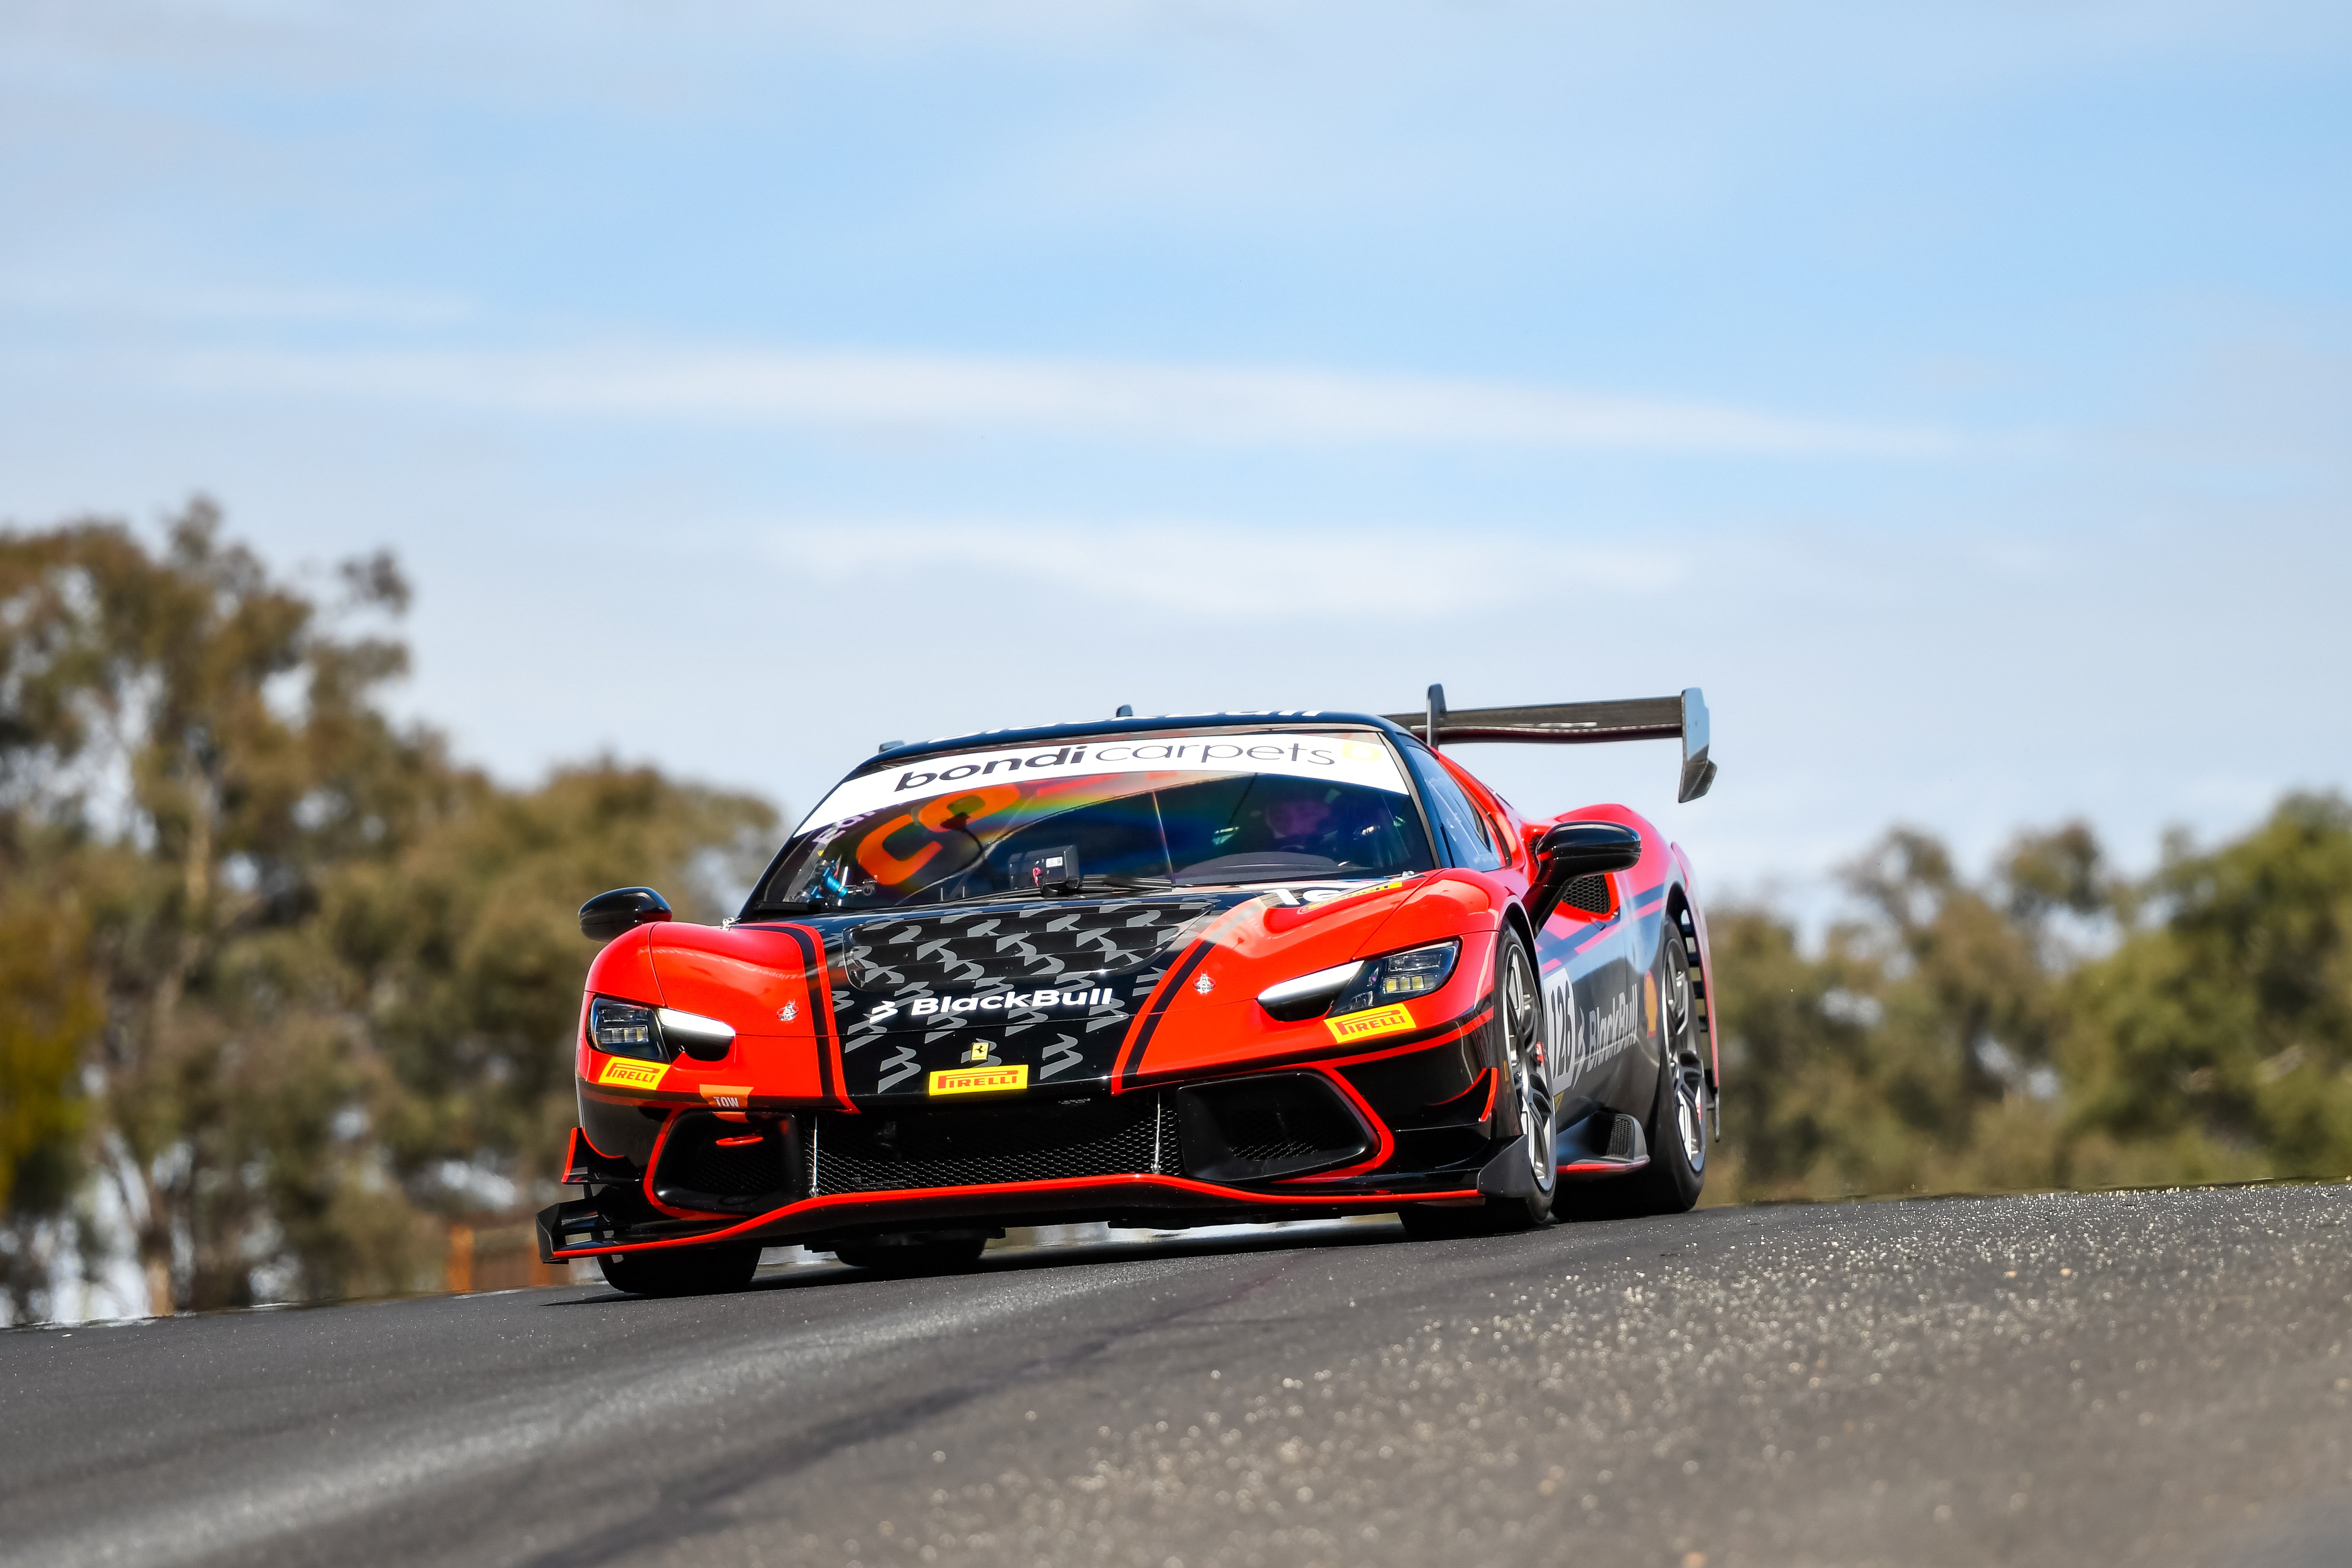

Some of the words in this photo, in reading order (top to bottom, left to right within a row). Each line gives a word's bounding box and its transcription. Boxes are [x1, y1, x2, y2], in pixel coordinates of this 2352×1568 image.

[894, 746, 1088, 792] bondi
[1096, 743, 1335, 765] carpets
[911, 988, 1113, 1016] BlackBull
[1334, 1009, 1406, 1036] PIRELLI
[1551, 980, 1572, 1080] 126
[1586, 983, 1638, 1072] BlackBull
[606, 1062, 660, 1083] PIRELLI
[938, 1070, 1019, 1089] PIRELLI
[713, 1096, 740, 1108] TOW
